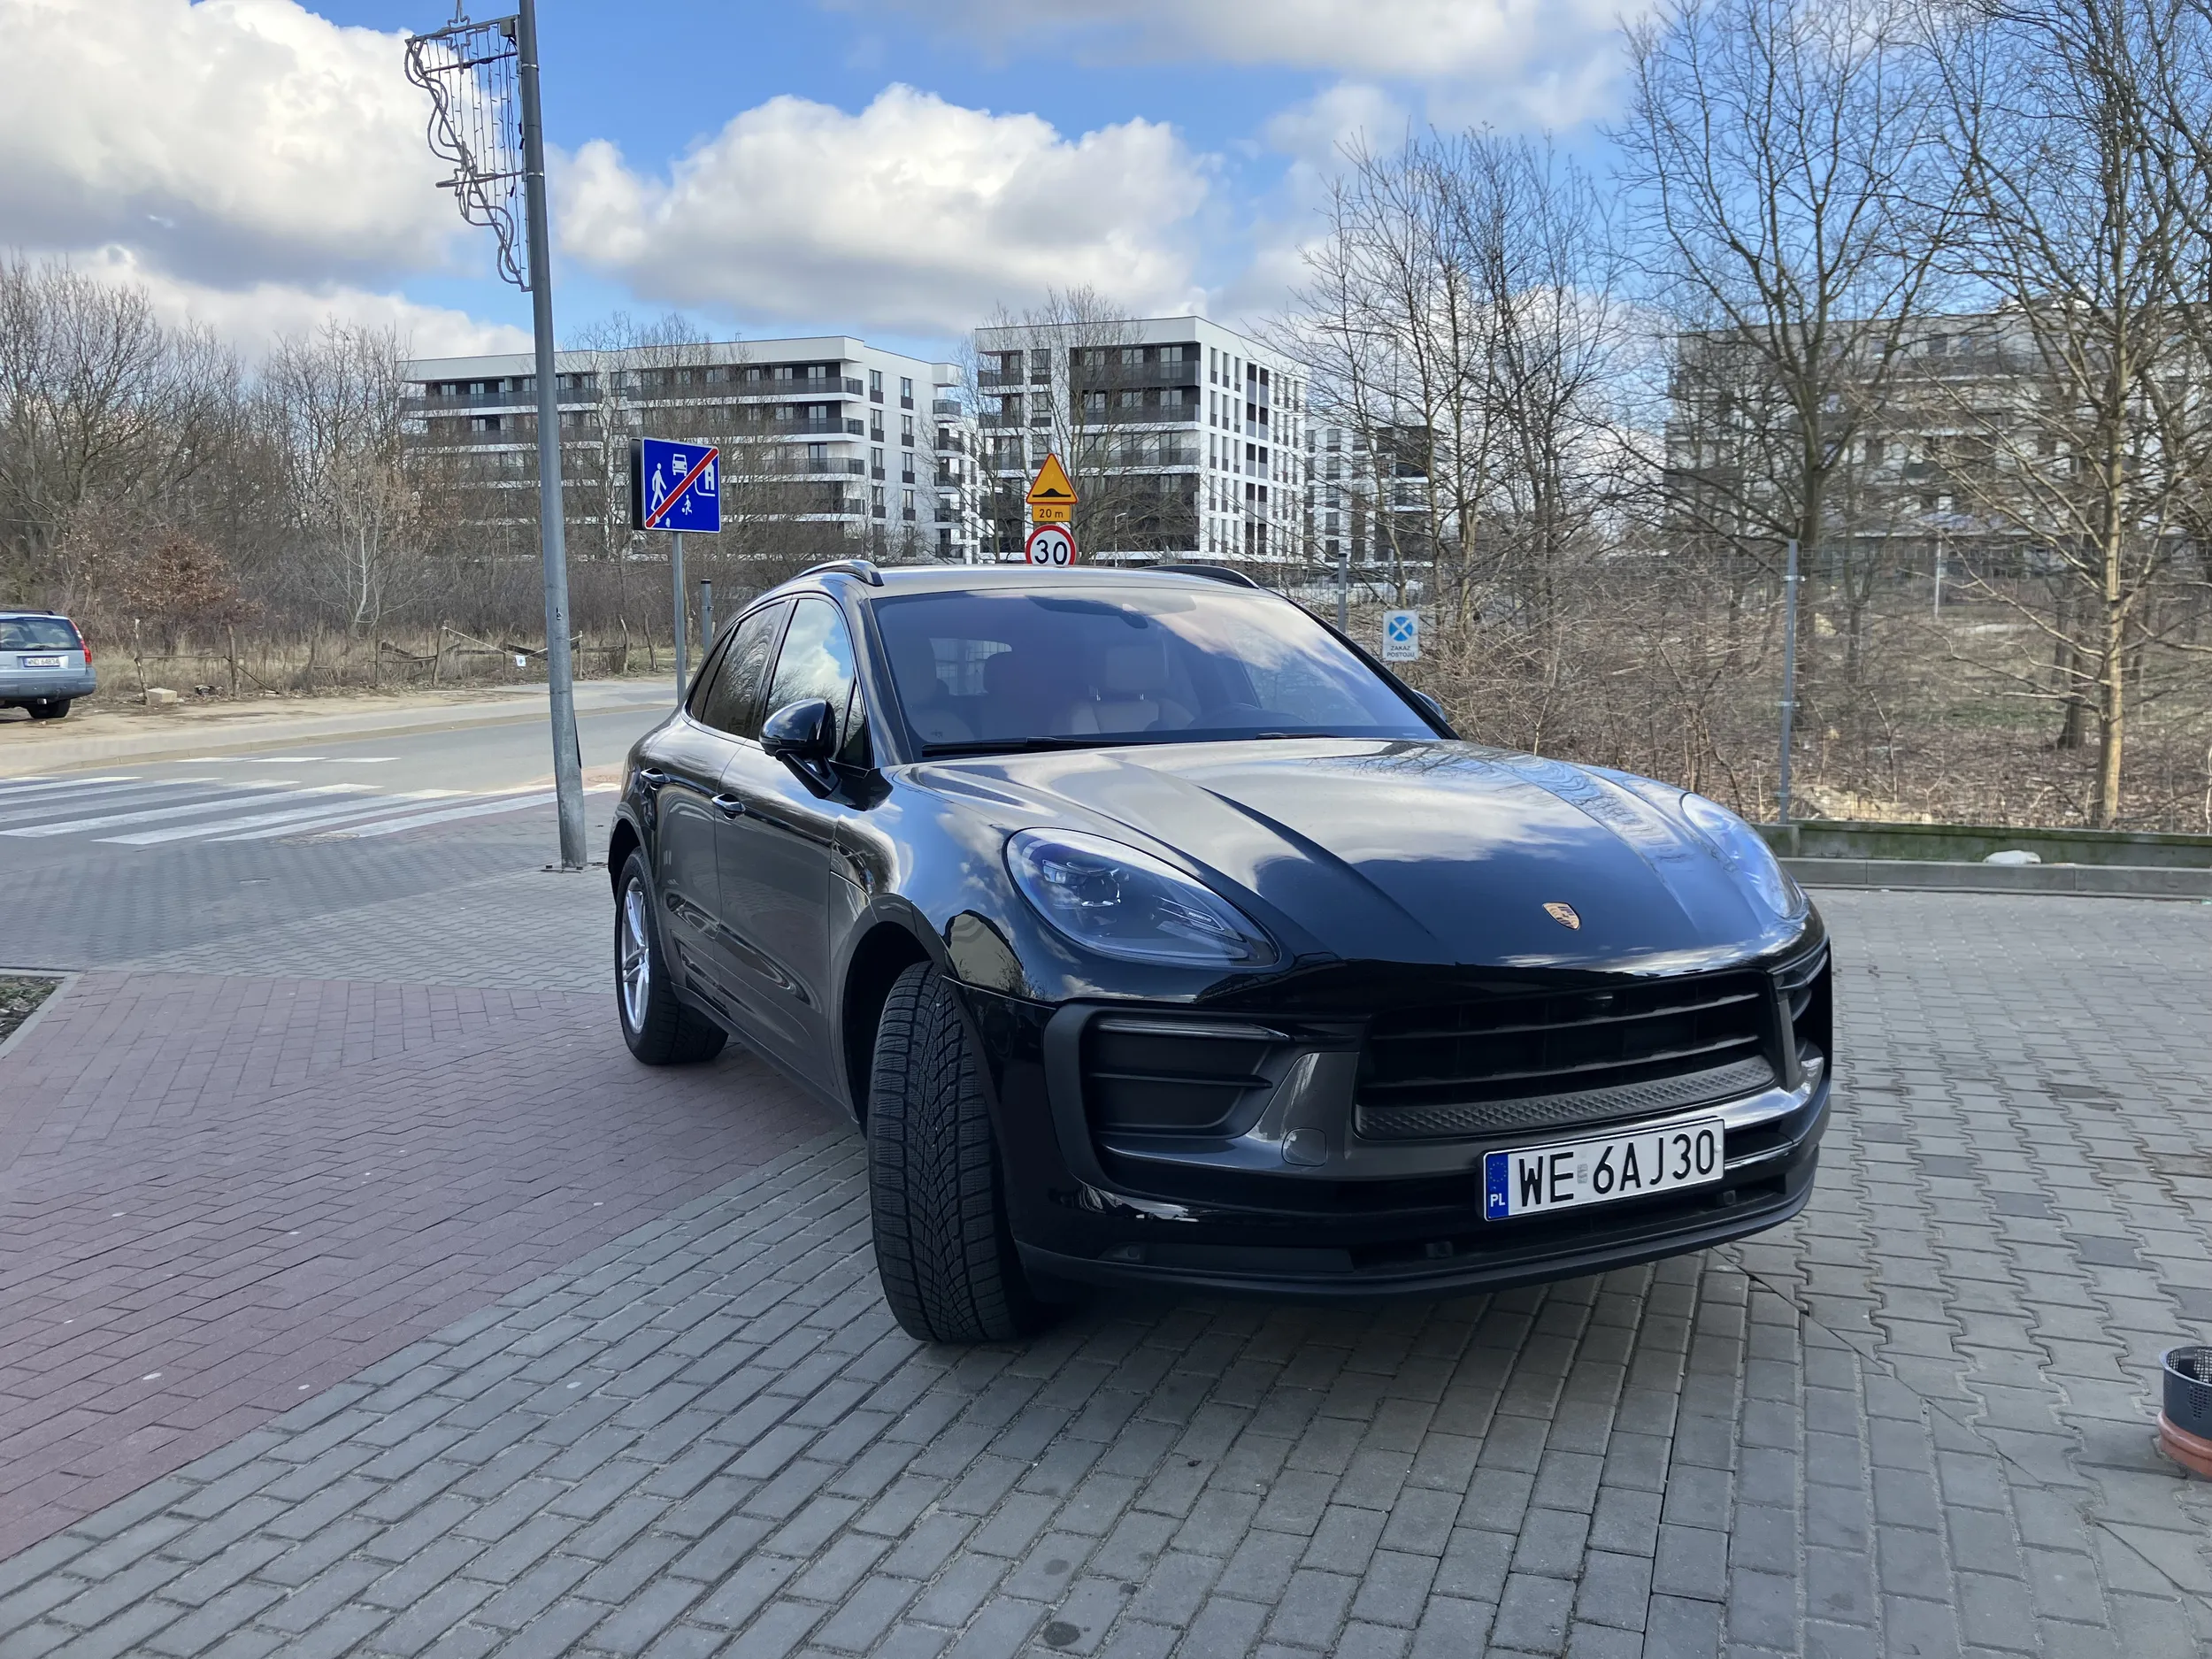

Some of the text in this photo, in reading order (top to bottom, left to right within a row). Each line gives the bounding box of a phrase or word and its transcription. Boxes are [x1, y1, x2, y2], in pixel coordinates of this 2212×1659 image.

[1040, 509, 1052, 518] 20
[1034, 539, 1067, 565] 30
[1518, 1127, 1715, 1208] WE 6AJ30
[1489, 1193, 1506, 1208] PL
